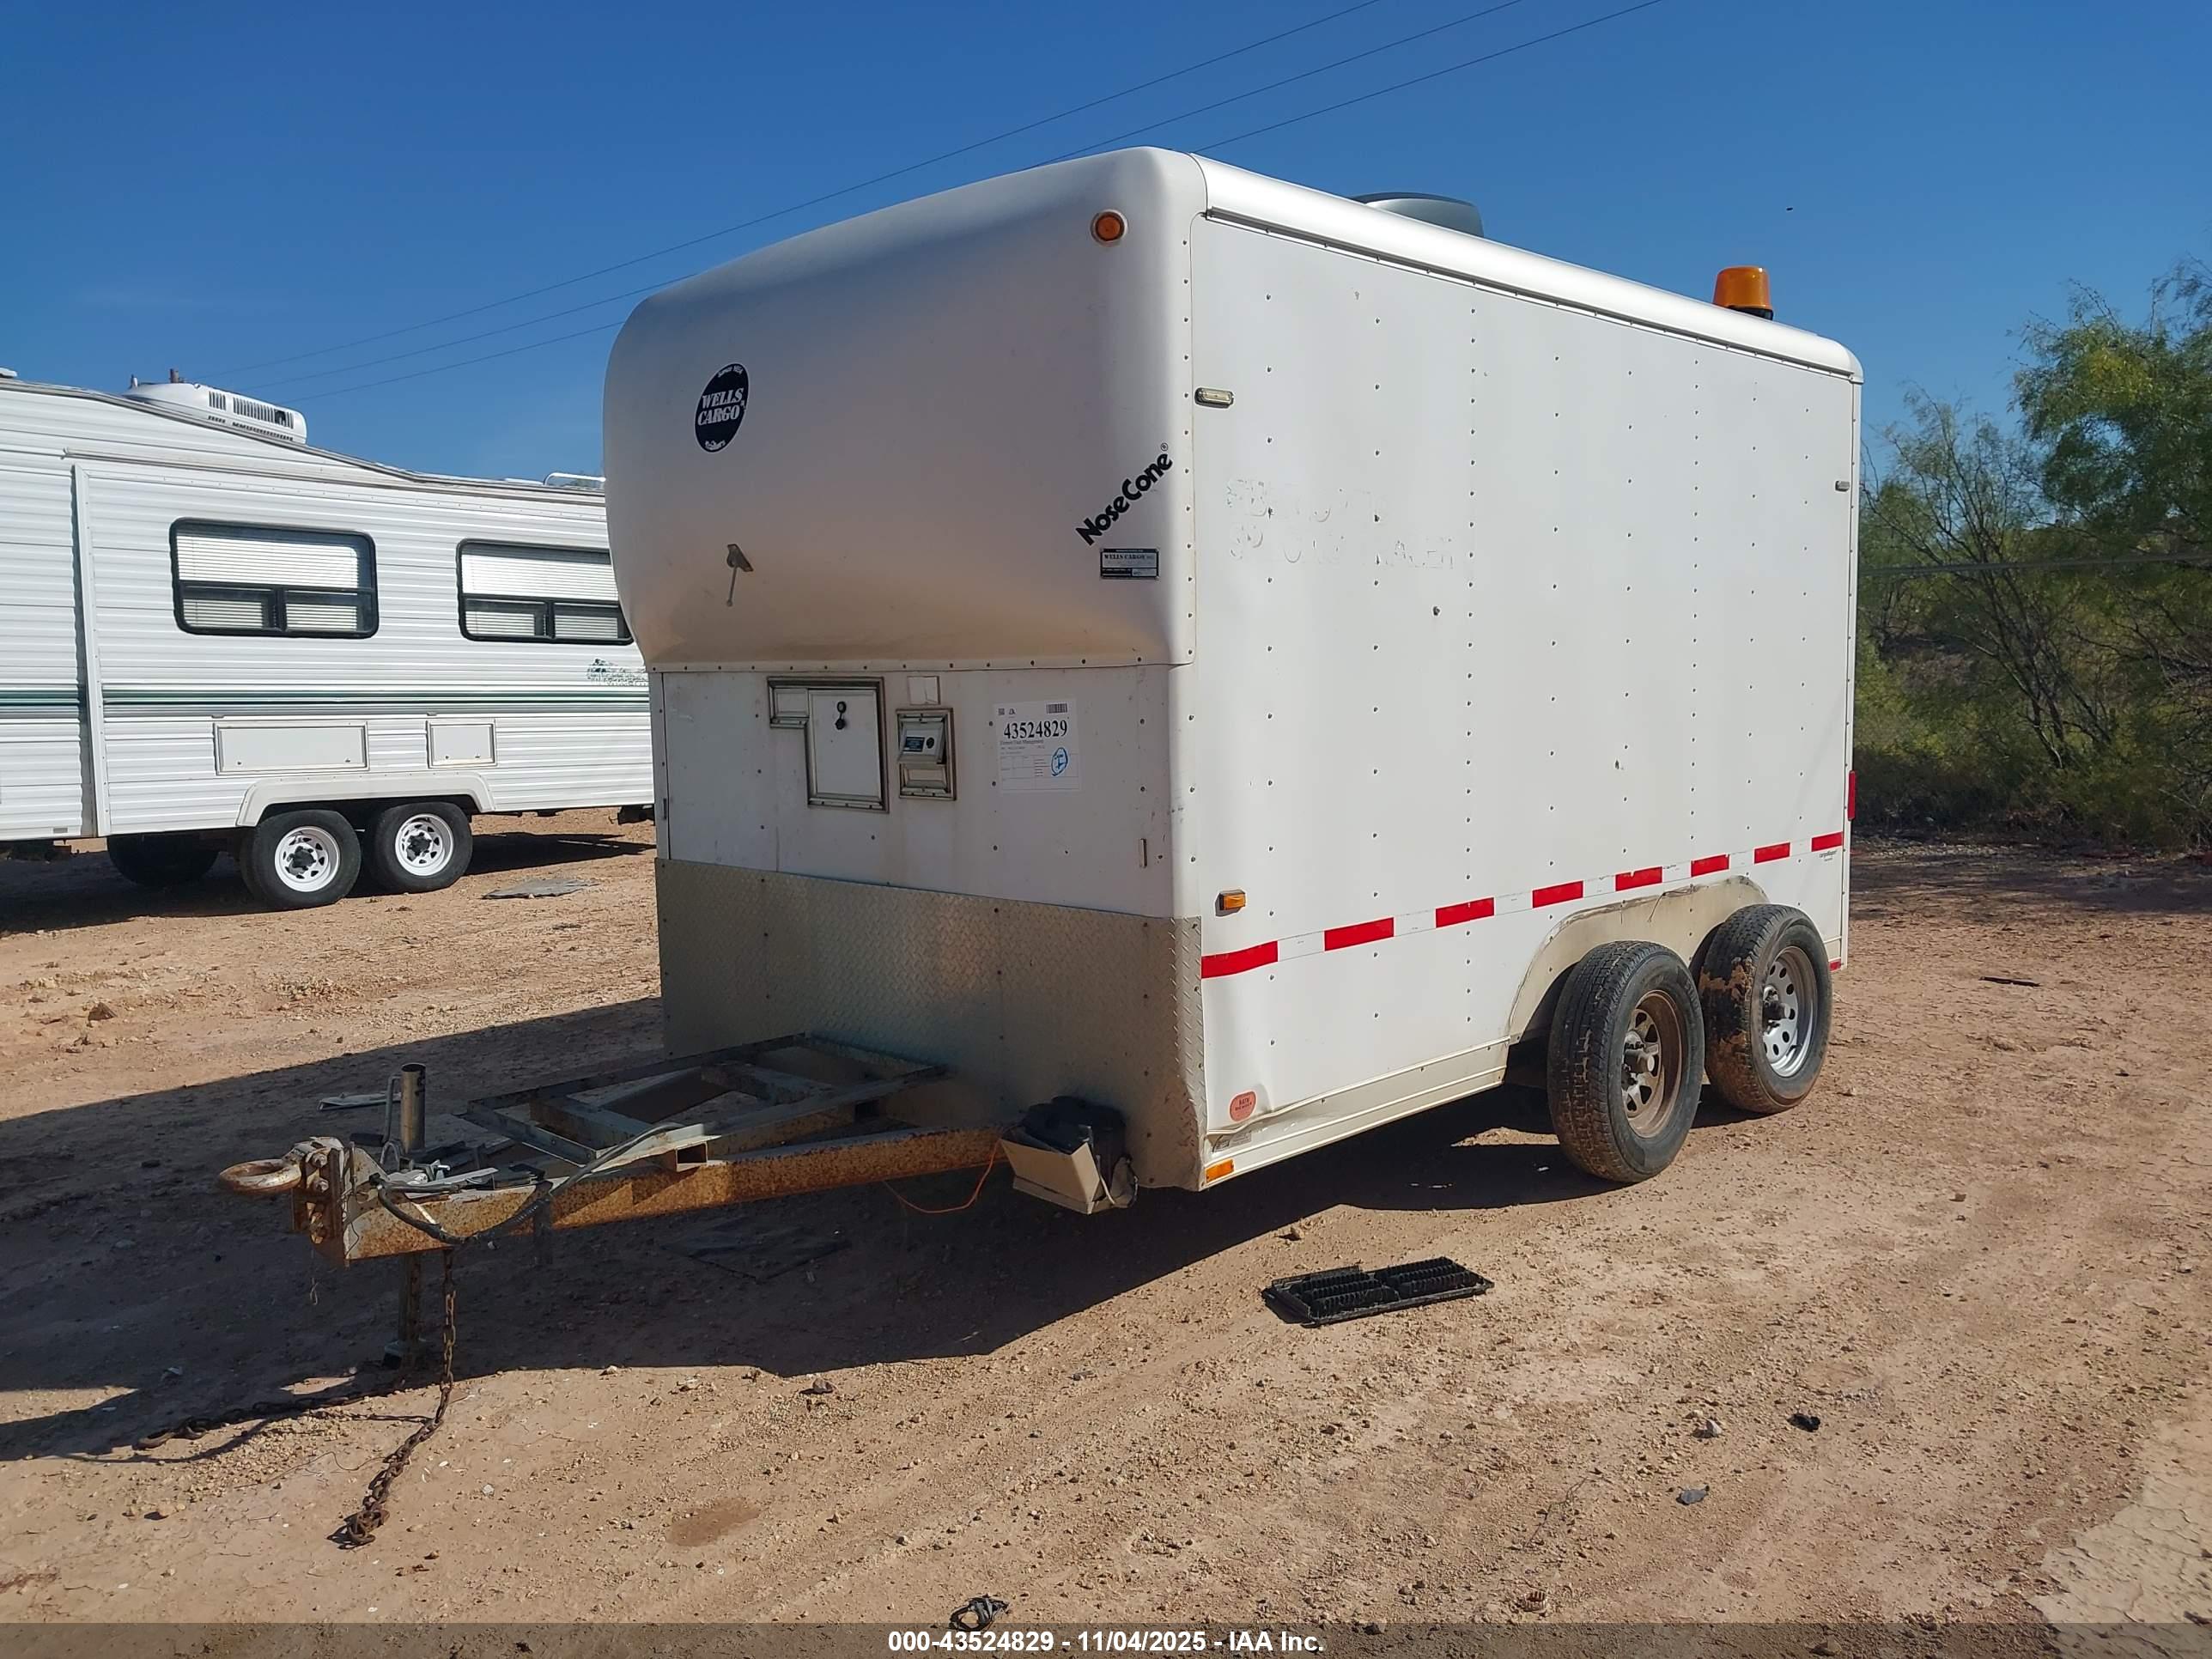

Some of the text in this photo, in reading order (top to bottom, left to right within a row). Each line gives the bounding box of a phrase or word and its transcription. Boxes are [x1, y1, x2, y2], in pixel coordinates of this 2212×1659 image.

[702, 387, 744, 409] WELLS
[697, 404, 740, 426] CARGO
[1003, 720, 1068, 739] 43524829
